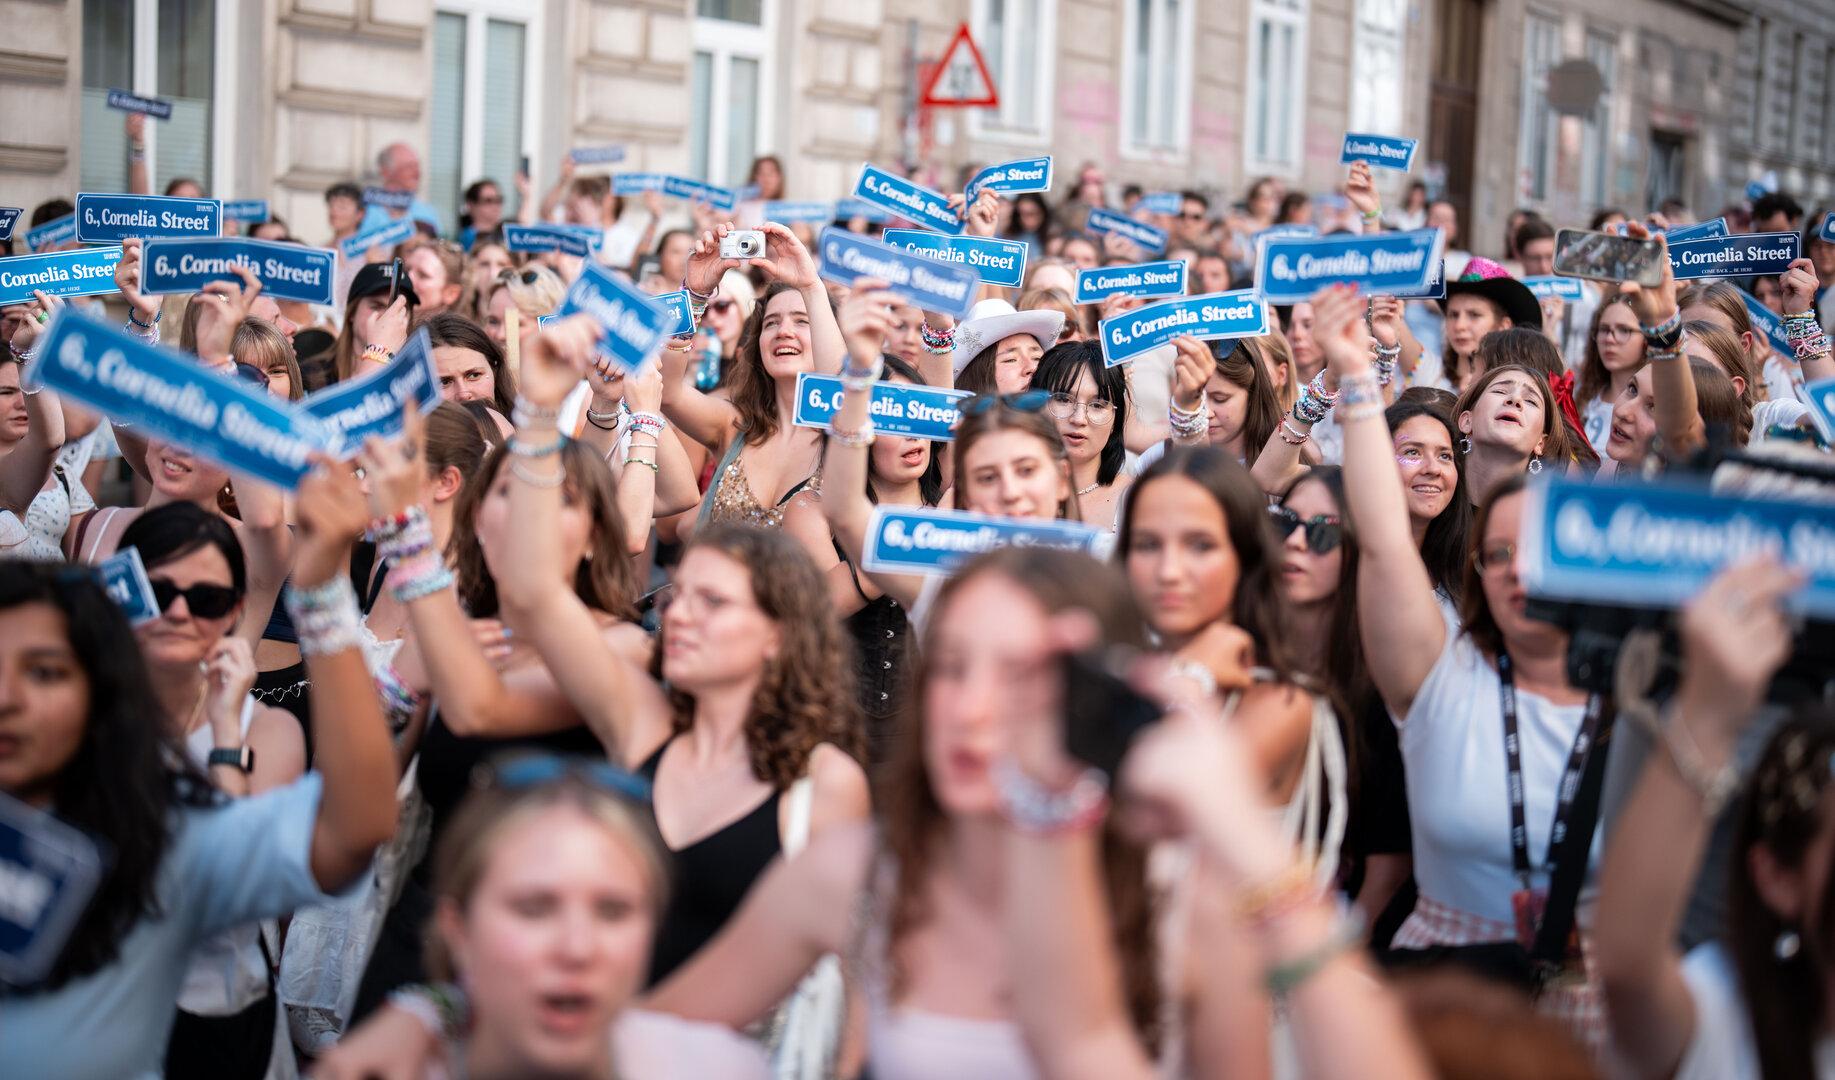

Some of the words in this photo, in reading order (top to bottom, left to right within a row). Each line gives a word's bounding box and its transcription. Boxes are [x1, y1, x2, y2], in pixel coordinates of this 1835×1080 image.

[1380, 144, 1408, 160] Street
[1007, 168, 1044, 181] Street
[879, 182, 926, 212] Cornelia
[85, 208, 101, 227] 6.,
[102, 208, 158, 228] Cornelia
[161, 212, 210, 231] Street
[969, 249, 1014, 270] Street
[1682, 247, 1744, 265] Cornelia
[1747, 245, 1792, 261] Street
[0, 266, 70, 288] Cornelia
[155, 254, 178, 278] 6.,
[180, 253, 261, 276] Cornelia
[264, 258, 321, 286] Street
[1097, 273, 1142, 290] Cornelia
[1143, 271, 1178, 285] Street
[1111, 327, 1132, 346] 6.,
[1131, 308, 1199, 339] Cornelia
[1201, 303, 1254, 323] Street
[808, 388, 830, 412] 6.,
[831, 389, 903, 418] Cnelia
[906, 399, 961, 425] Street
